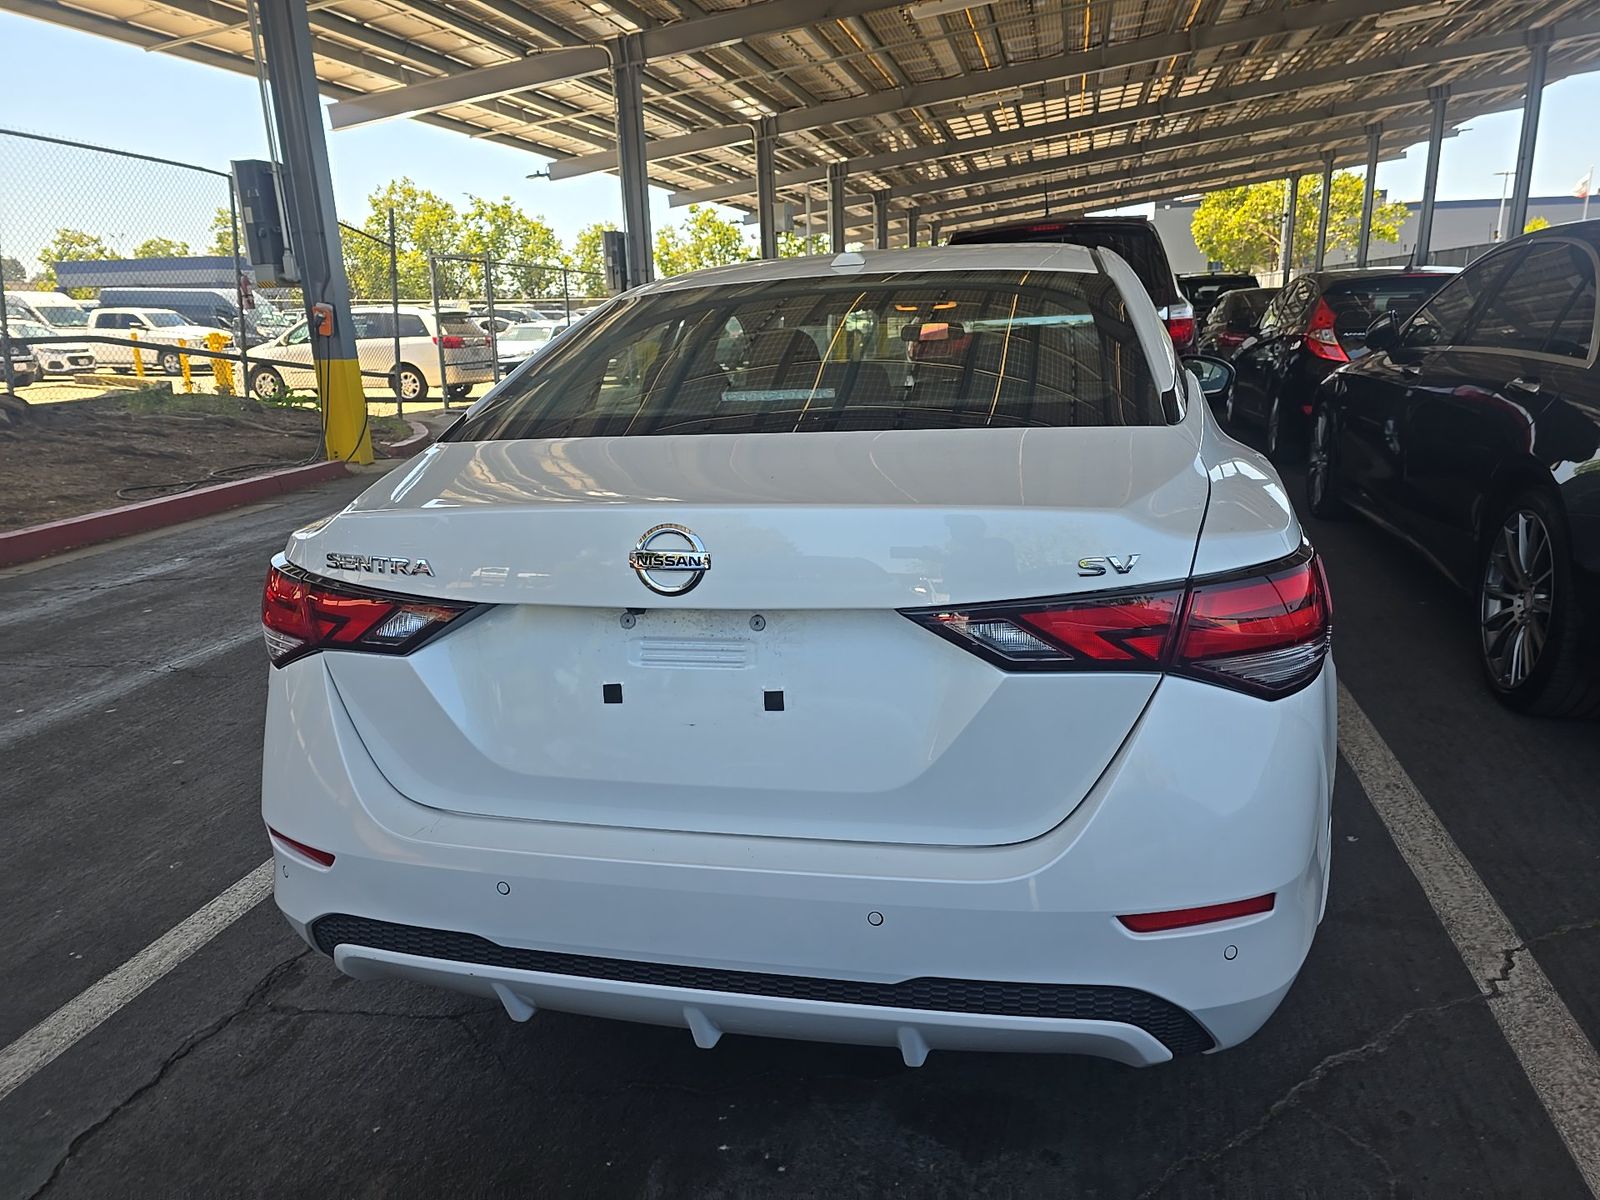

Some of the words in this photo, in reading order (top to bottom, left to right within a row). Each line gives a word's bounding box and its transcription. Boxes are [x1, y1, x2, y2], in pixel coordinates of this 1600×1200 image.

[326, 552, 435, 577] SENTRA
[636, 555, 701, 567] NISSAN
[1078, 554, 1141, 577] SV
